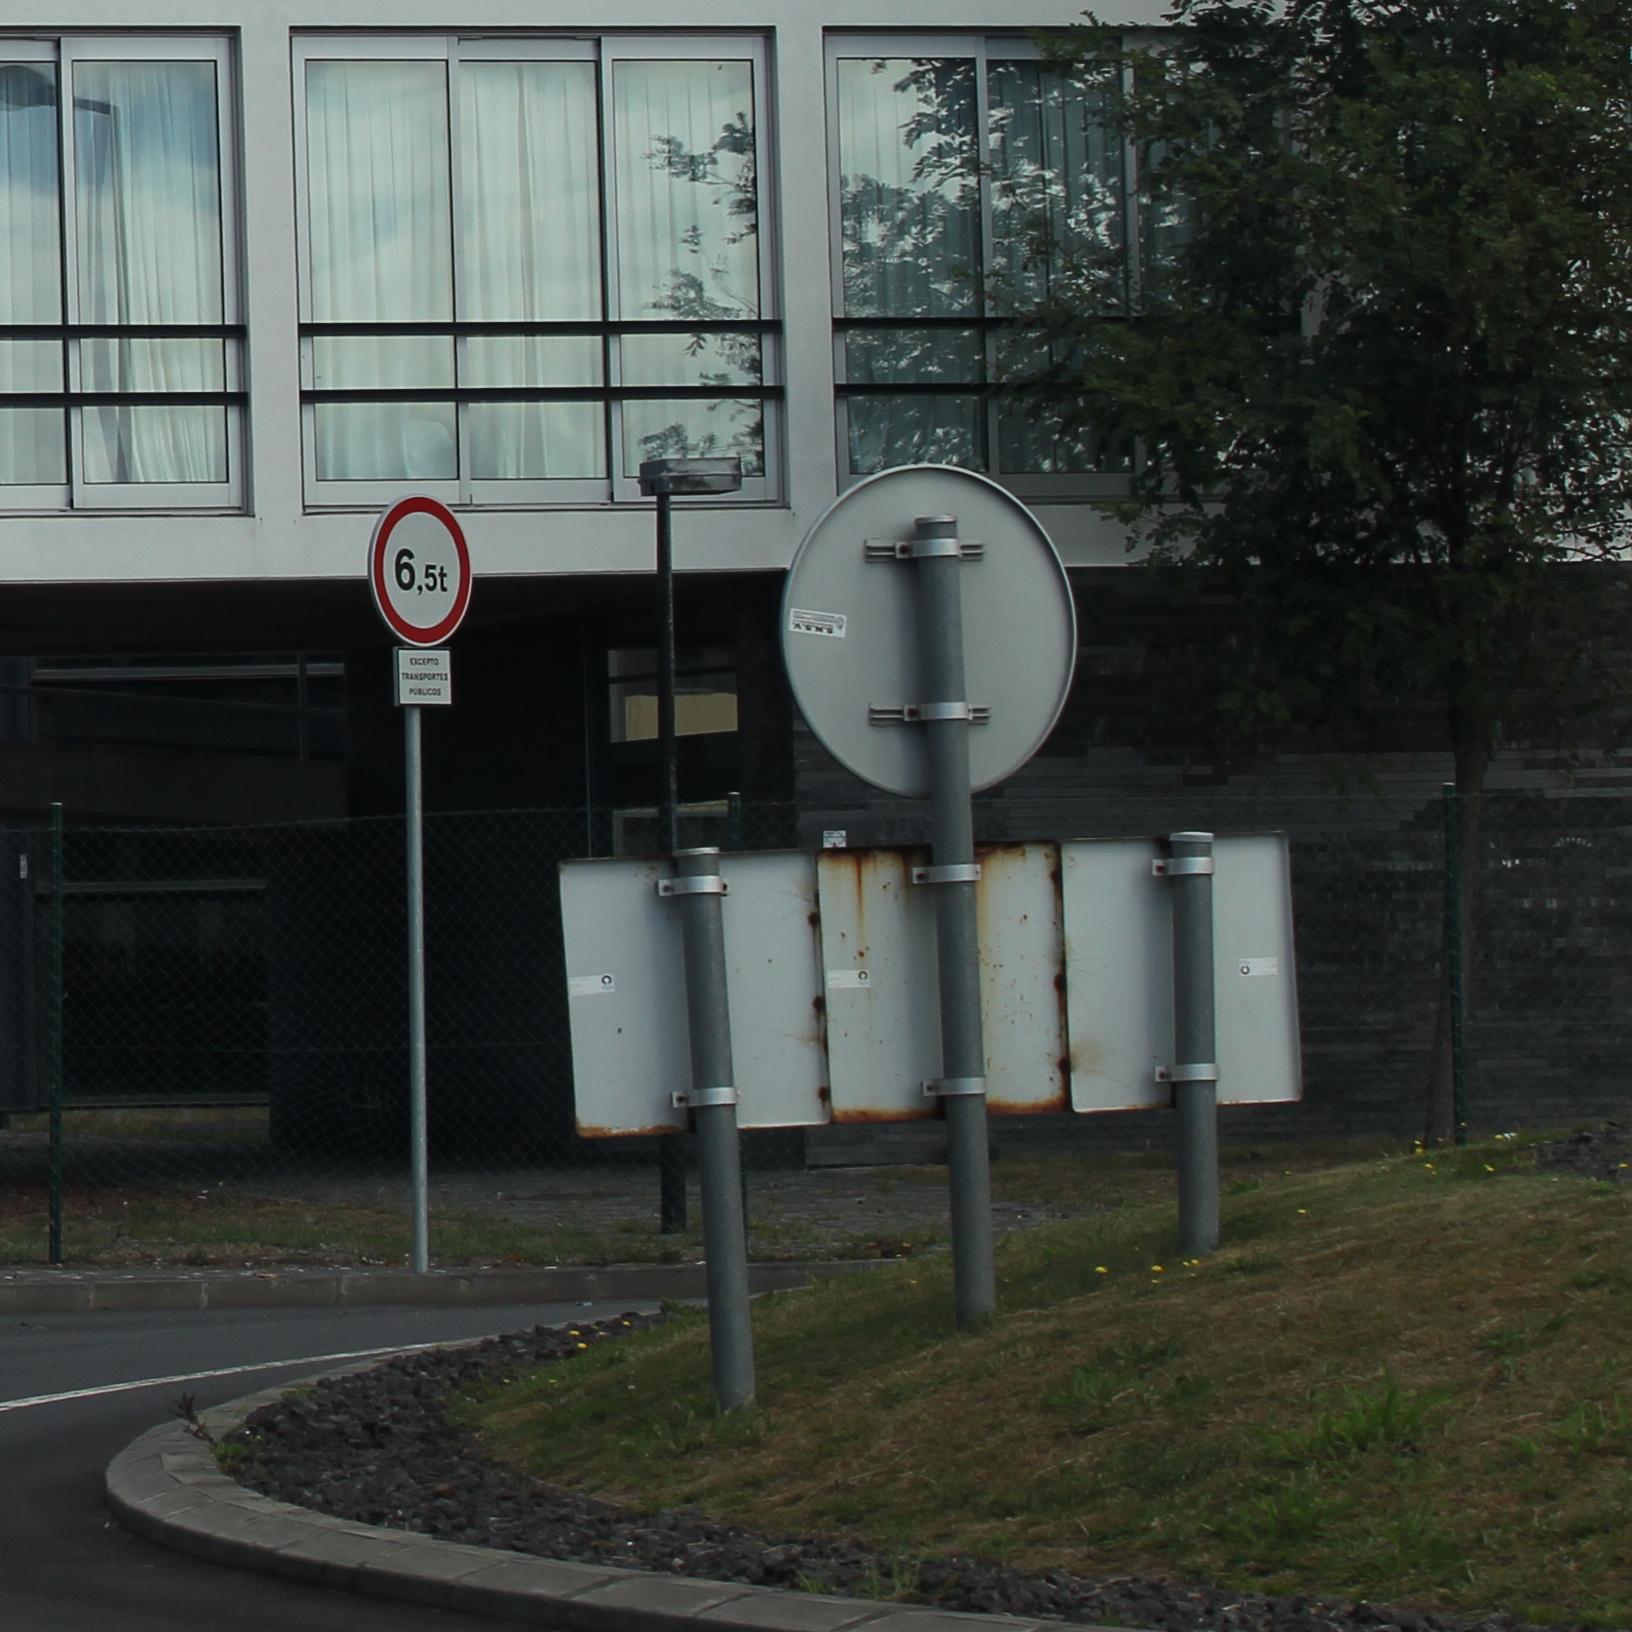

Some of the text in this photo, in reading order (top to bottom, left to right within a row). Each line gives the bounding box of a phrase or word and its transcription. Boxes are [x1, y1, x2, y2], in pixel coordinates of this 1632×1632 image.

[394, 548, 448, 596] 6,5t
[409, 657, 439, 666] EXCEPTO
[400, 672, 449, 681] TRANSPORTES
